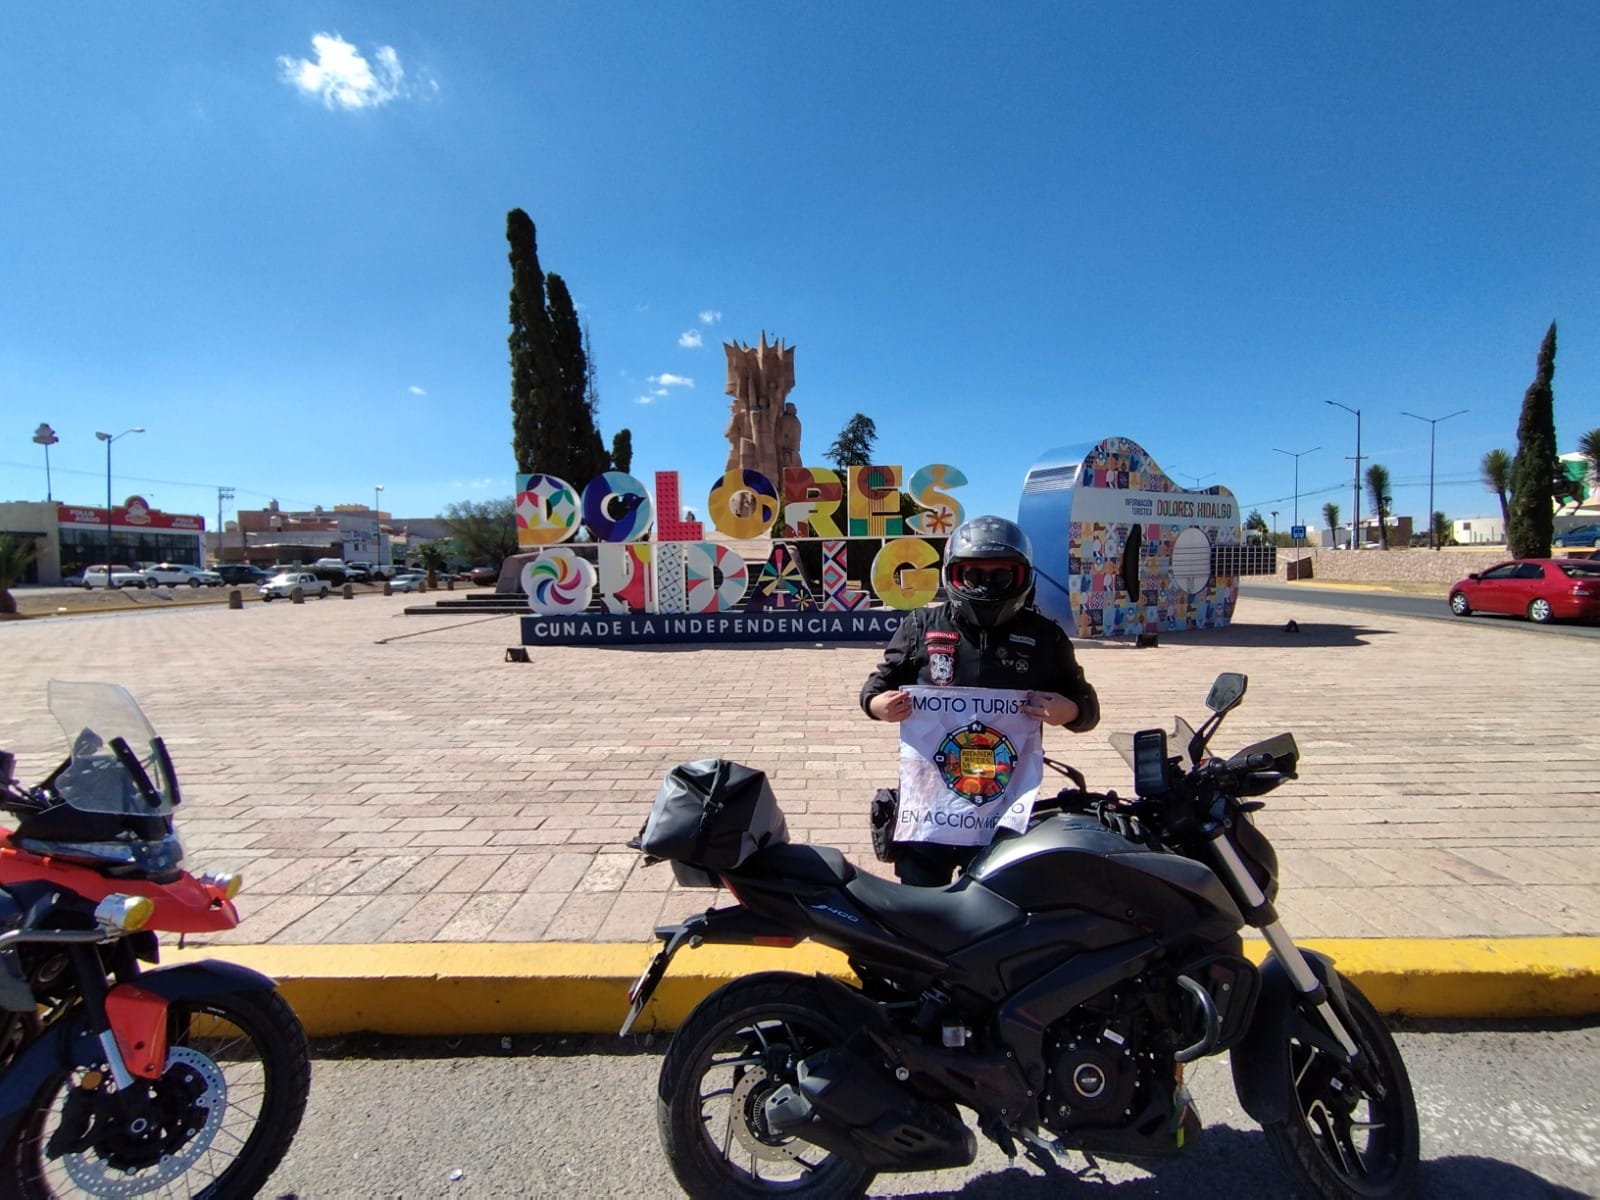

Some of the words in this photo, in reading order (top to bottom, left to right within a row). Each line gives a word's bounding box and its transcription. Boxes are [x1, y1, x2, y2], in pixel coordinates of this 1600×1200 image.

[516, 463, 968, 546] DOLORES
[1156, 499, 1194, 518] DOLORES
[1197, 501, 1232, 519] HIDALGO
[598, 537, 940, 615] HIDALG
[631, 620, 656, 635] LA
[664, 617, 843, 634] INDEPENDENCIA
[913, 695, 967, 713] MOTO
[972, 723, 982, 731] N
[974, 795, 983, 803] S
[901, 810, 920, 824] EN
[923, 811, 982, 830] ACCIÓN
